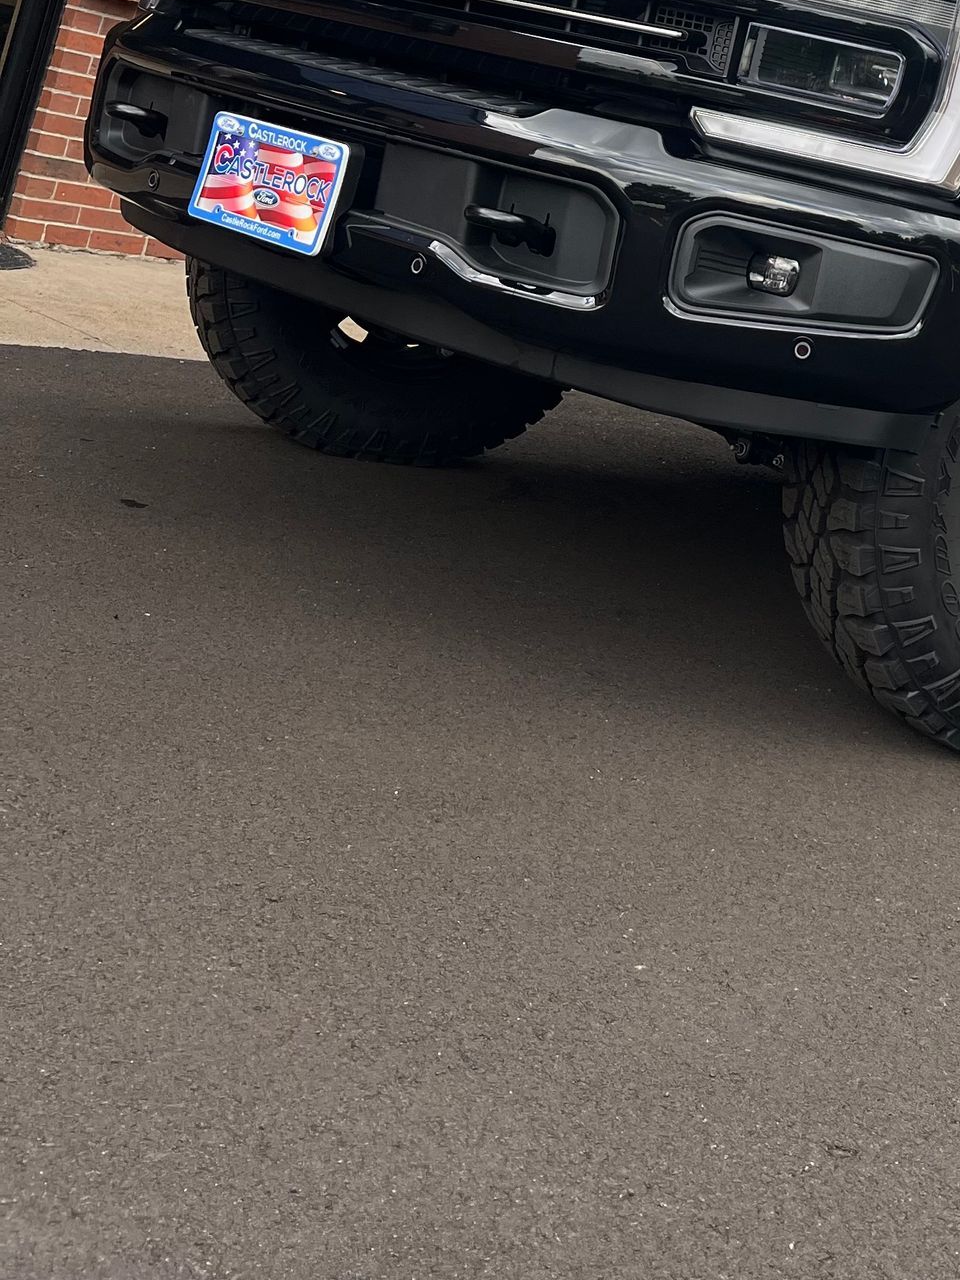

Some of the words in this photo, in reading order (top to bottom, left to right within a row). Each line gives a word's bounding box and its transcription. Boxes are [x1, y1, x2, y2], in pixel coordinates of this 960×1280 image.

[214, 143, 333, 203] CASTLEROCK
[256, 190, 275, 205] Ford
[221, 213, 281, 240] CastleRockFord.com
